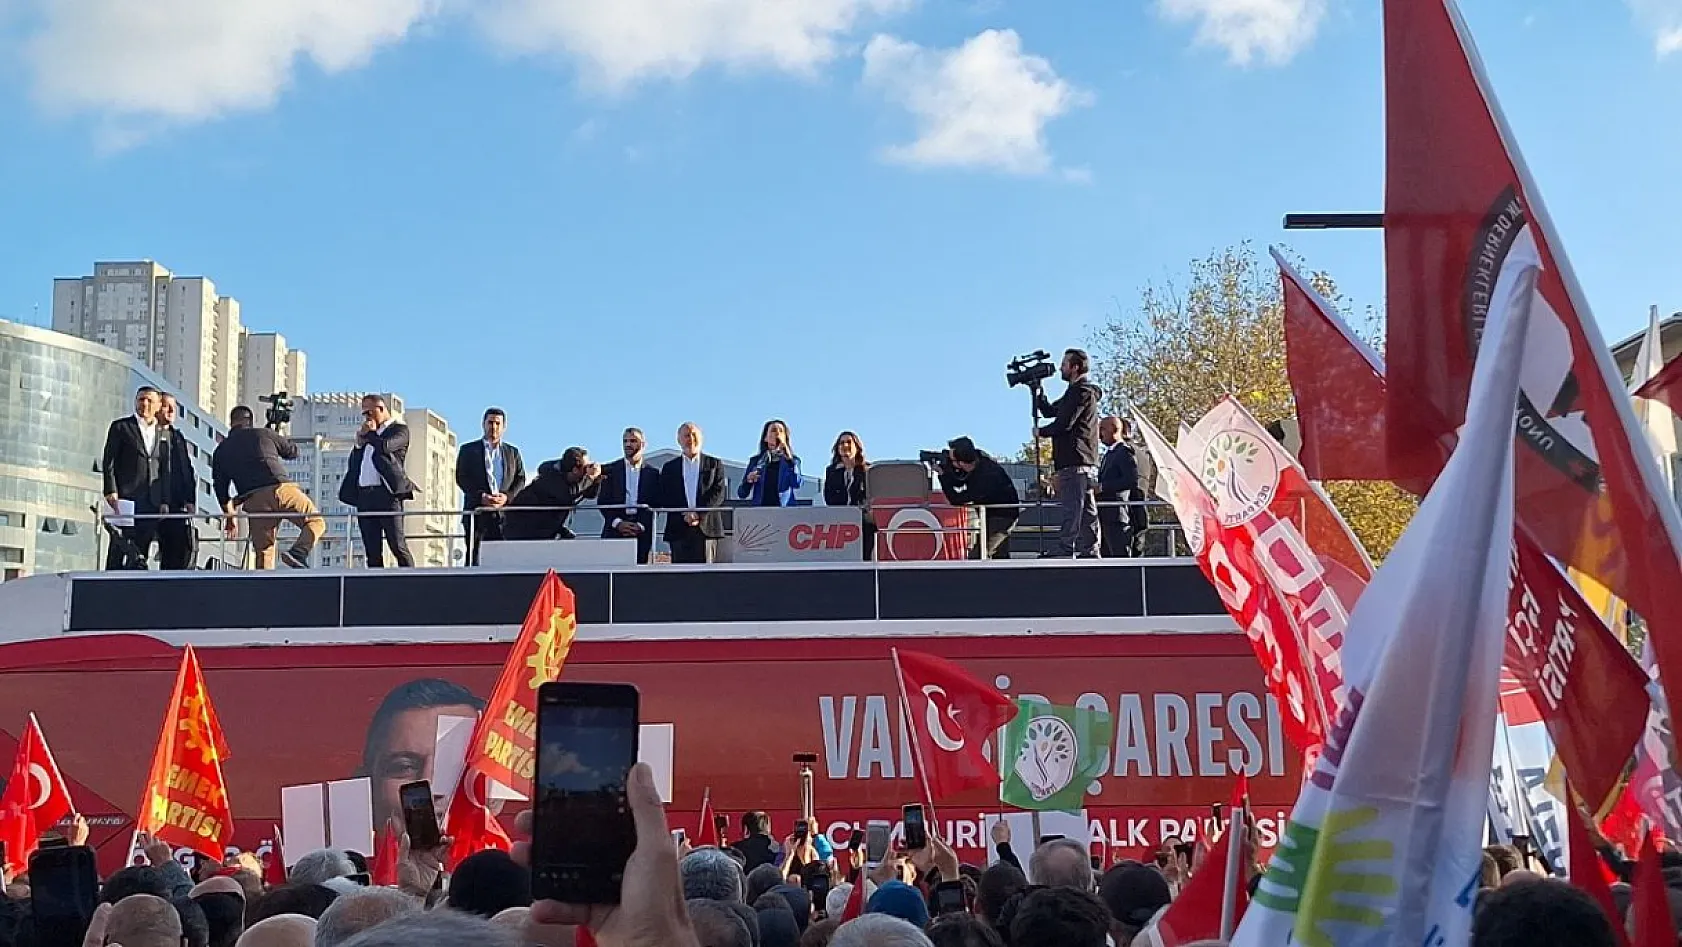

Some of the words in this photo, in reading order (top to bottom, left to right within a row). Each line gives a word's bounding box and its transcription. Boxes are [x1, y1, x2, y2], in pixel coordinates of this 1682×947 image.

[788, 523, 860, 550] CHP
[483, 730, 537, 779] PARTİS
[165, 764, 223, 809] EMEK
[1088, 819, 1150, 847] ALK
